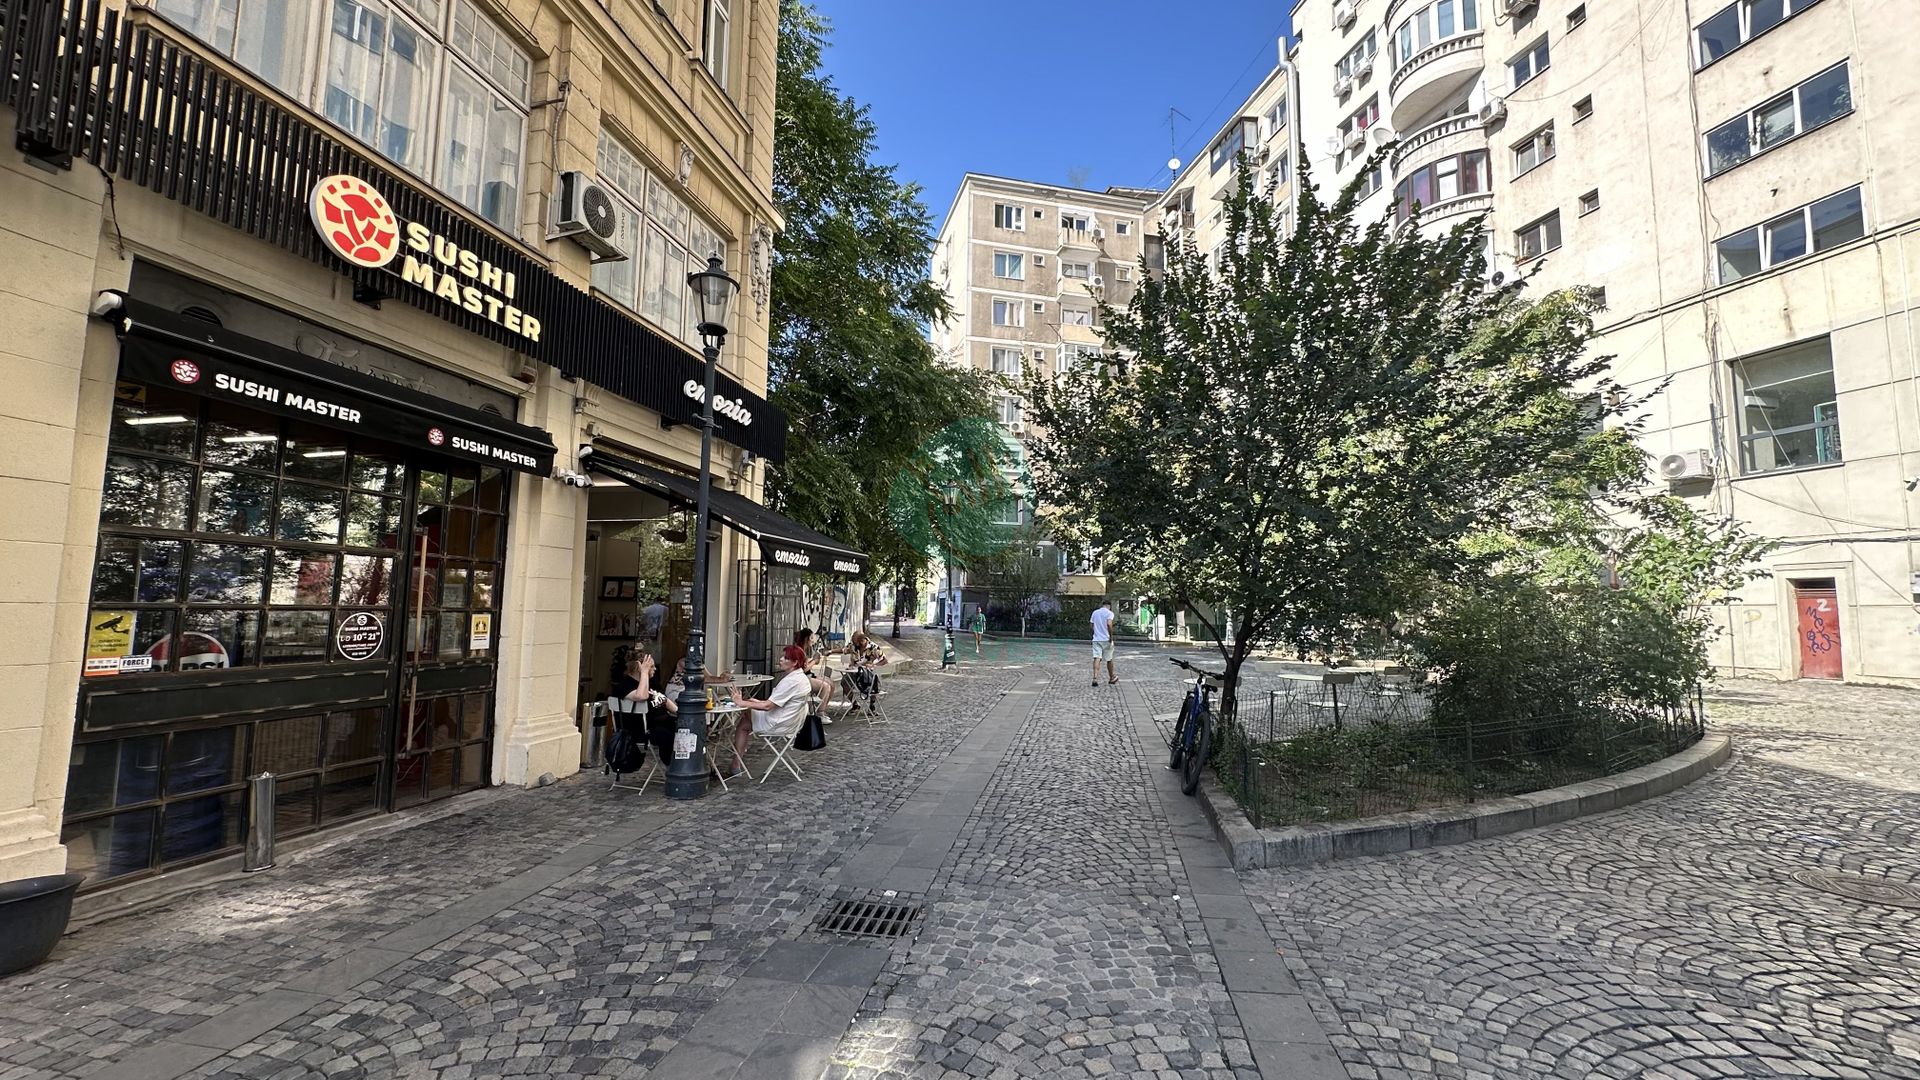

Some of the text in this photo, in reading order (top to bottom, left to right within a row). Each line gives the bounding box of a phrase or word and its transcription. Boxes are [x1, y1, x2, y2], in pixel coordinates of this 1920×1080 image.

[406, 222, 516, 299] SUSHI
[402, 255, 541, 342] MASTER
[215, 373, 361, 423] SUSHI MASTER
[452, 436, 537, 468] SUSHI MASTER
[774, 549, 811, 567] emozia
[833, 558, 861, 574] emozia
[1817, 599, 1832, 611] 2
[122, 658, 144, 667] FORCE
